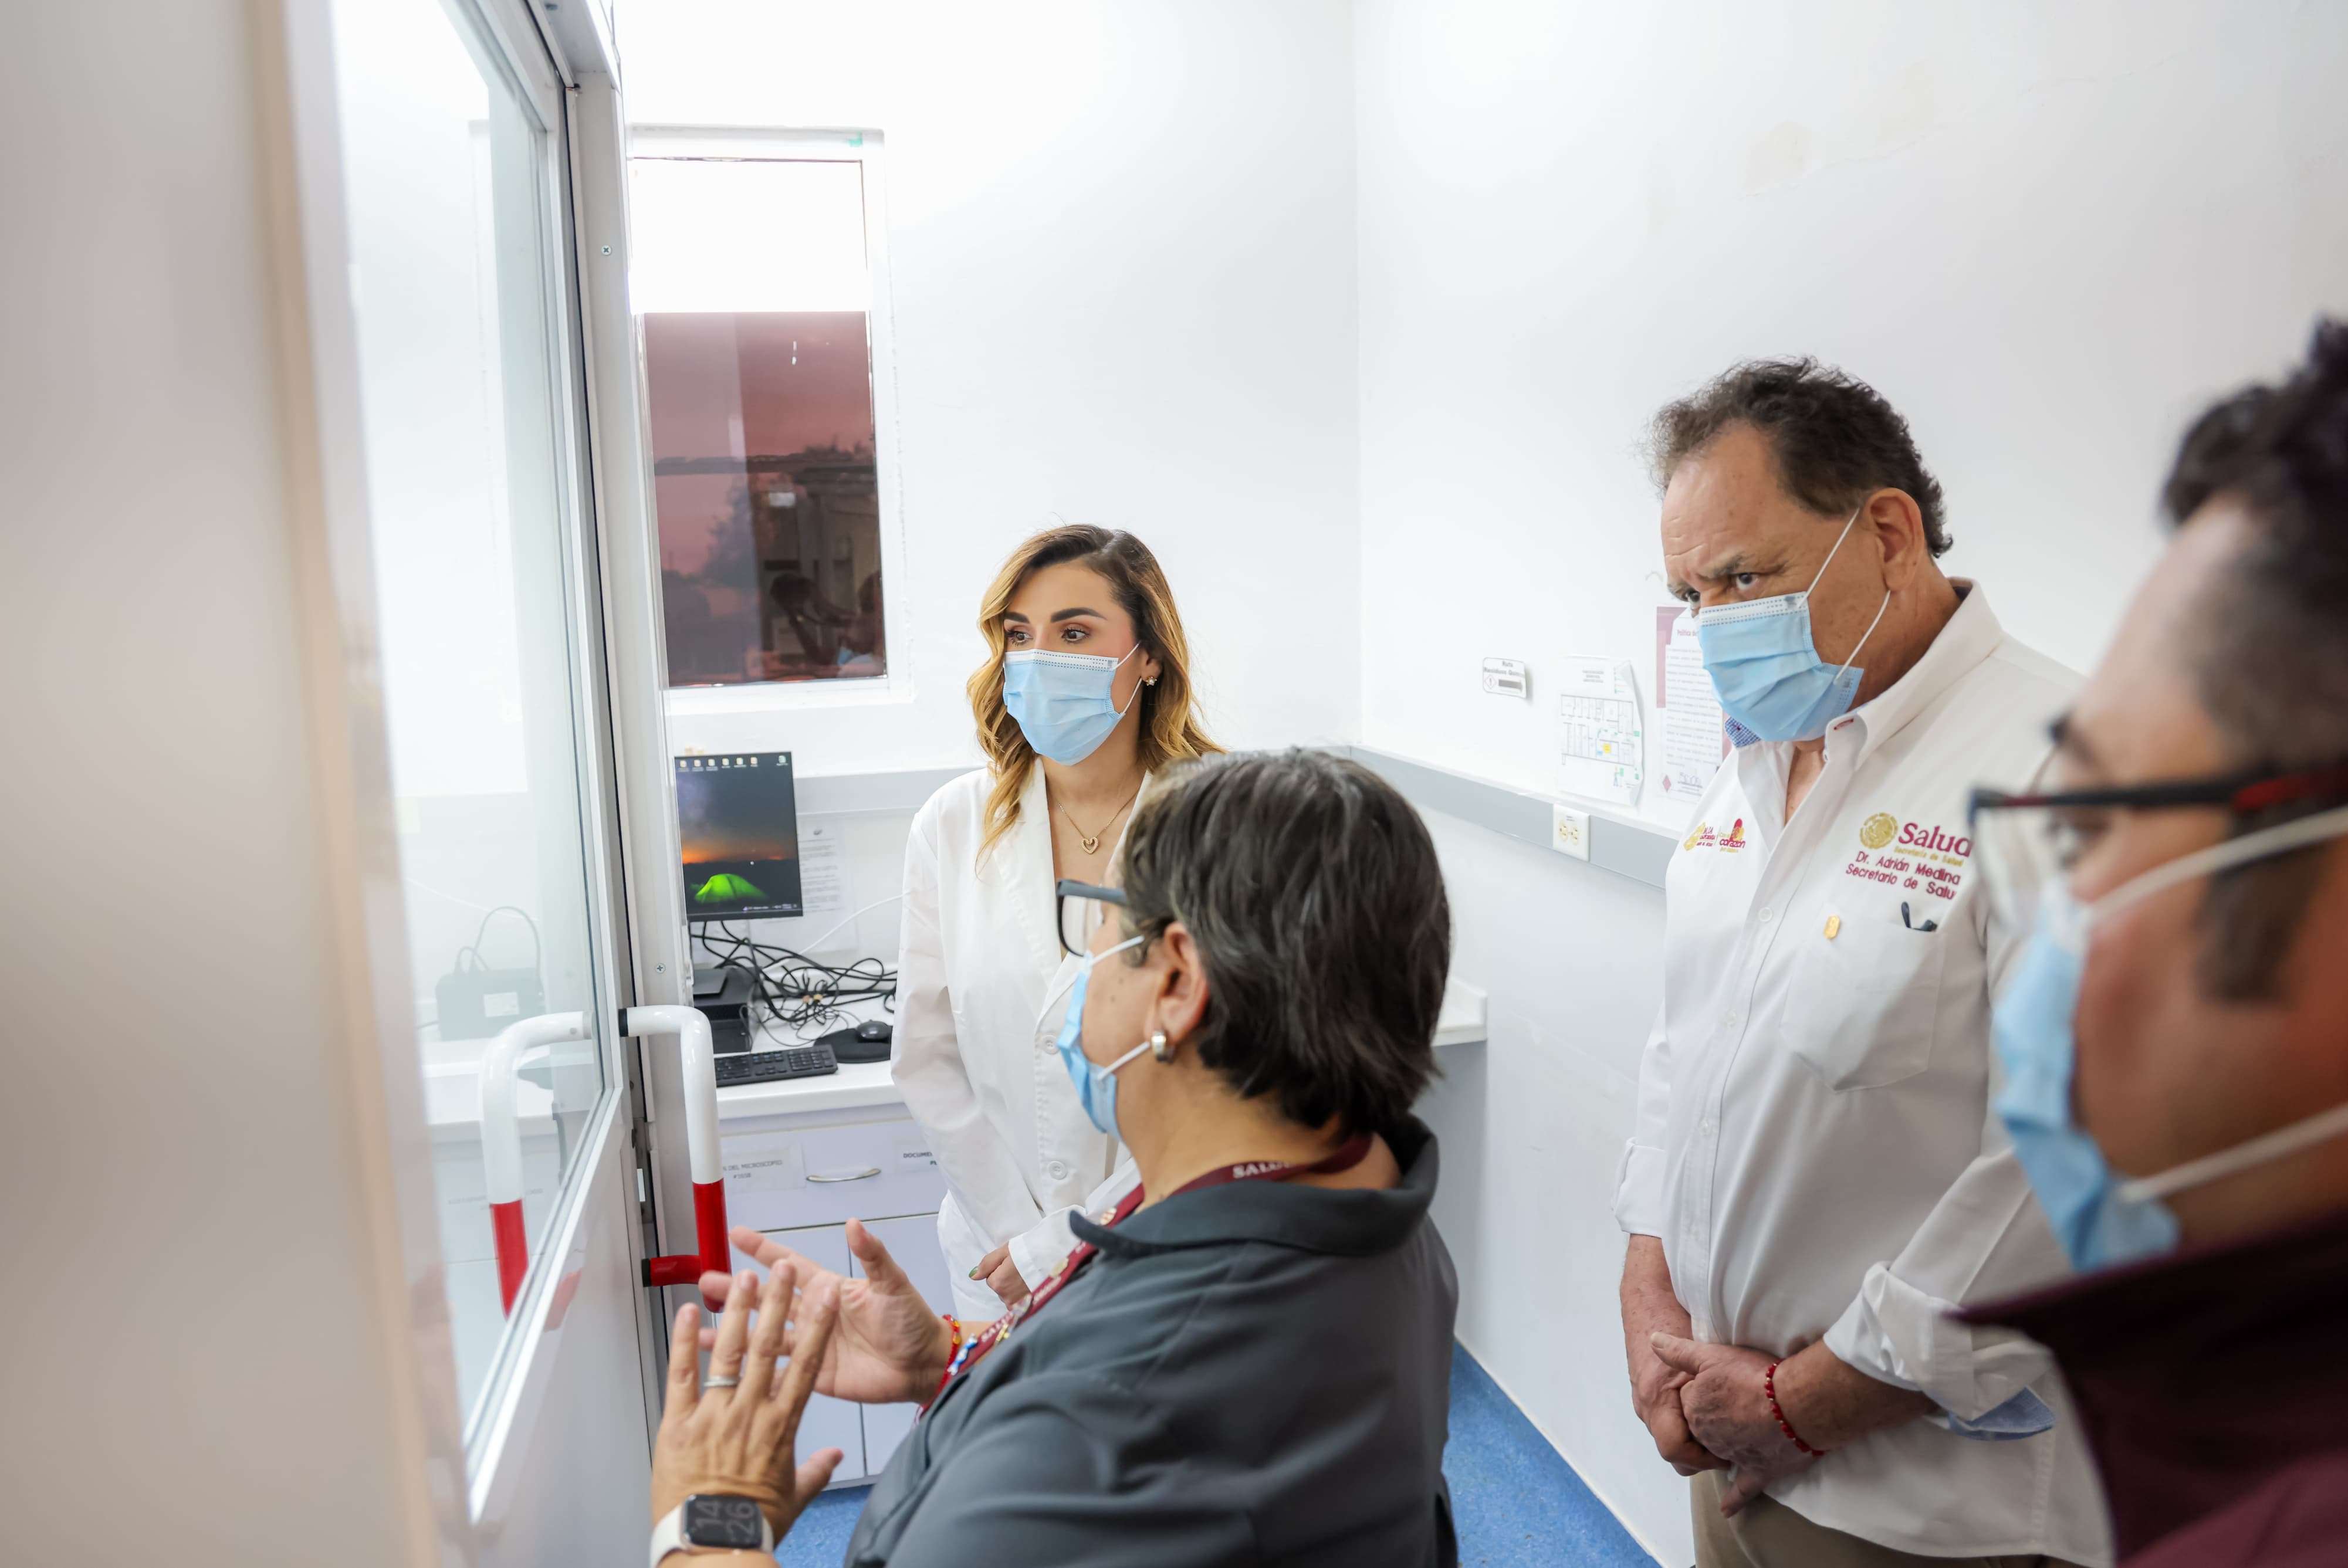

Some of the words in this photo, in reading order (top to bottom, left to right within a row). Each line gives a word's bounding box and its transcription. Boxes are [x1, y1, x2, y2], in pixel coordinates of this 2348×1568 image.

[1846, 863, 1898, 885] Secretario
[1903, 876, 1919, 889] de
[1926, 881, 1957, 900] Salu
[1856, 851, 1870, 865] Dr.
[1876, 856, 1910, 872] Adrián
[1915, 863, 1961, 886] Medina
[696, 1501, 723, 1529] 14
[725, 1502, 755, 1543] 26
